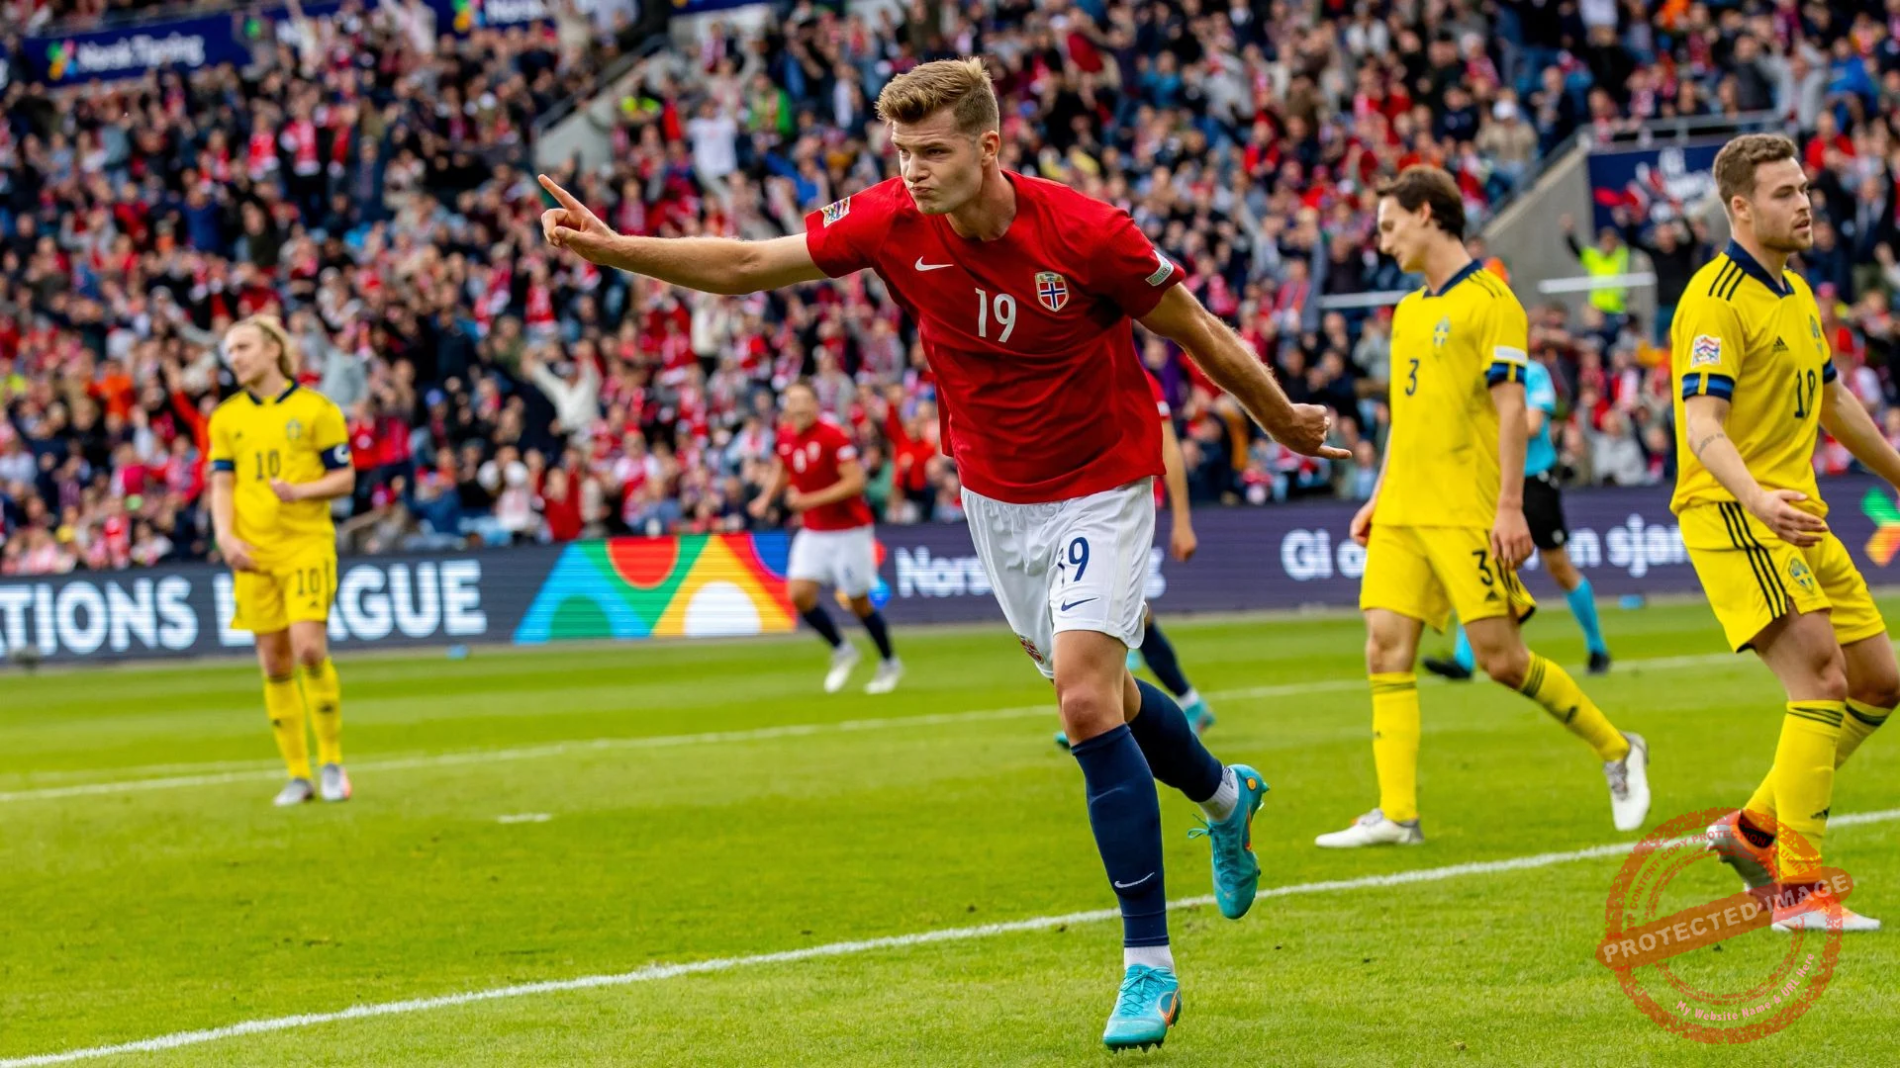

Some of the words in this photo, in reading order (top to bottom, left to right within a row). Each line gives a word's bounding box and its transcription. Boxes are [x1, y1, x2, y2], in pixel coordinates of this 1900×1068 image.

[975, 287, 1016, 343] 19
[1405, 358, 1420, 396] 3
[255, 449, 281, 481] 10
[296, 567, 321, 596] 10
[1472, 550, 1494, 586] 3
[0, 574, 199, 657] TIONS
[212, 559, 487, 647] LGUE
